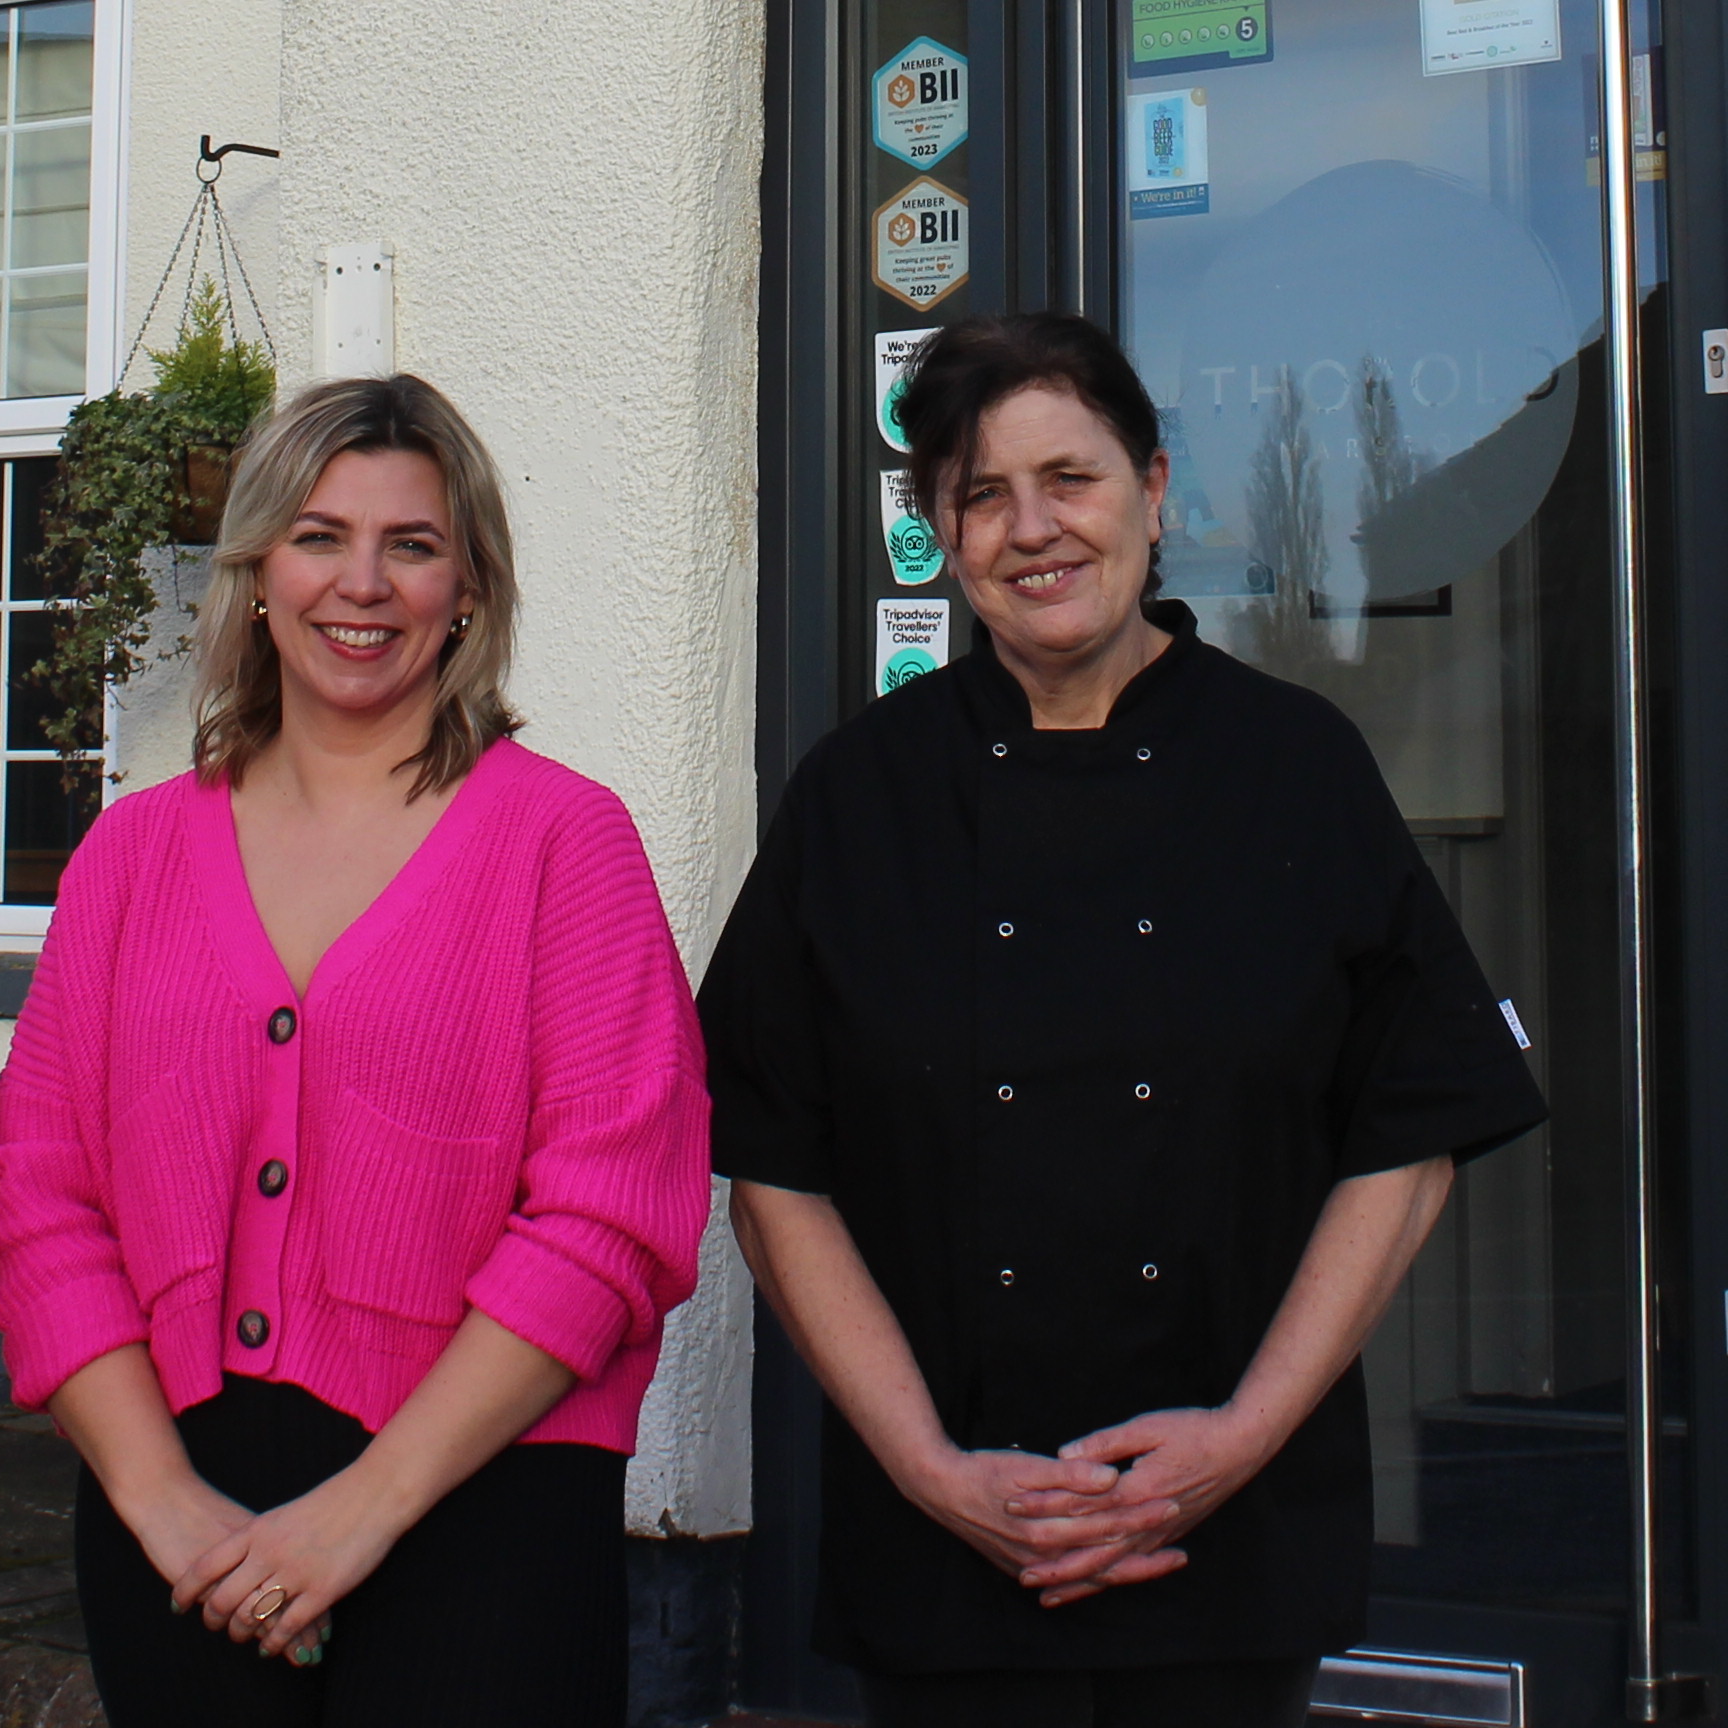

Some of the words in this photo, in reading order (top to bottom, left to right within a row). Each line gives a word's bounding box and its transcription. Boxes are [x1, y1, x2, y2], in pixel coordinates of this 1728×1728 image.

[1139, 1, 1171, 14] FOOD
[1241, 19, 1253, 39] 5
[901, 57, 944, 71] MEMBER
[920, 69, 959, 104] BII
[910, 144, 938, 157] 2023
[902, 197, 945, 209] MEMBER
[1141, 192, 1171, 203] We're
[1173, 190, 1185, 199] in
[920, 209, 959, 244] BII
[909, 284, 937, 297] 2022
[883, 609, 944, 621] Tripadvisor
[886, 621, 941, 632] Travellers'
[892, 633, 931, 643] Choice
